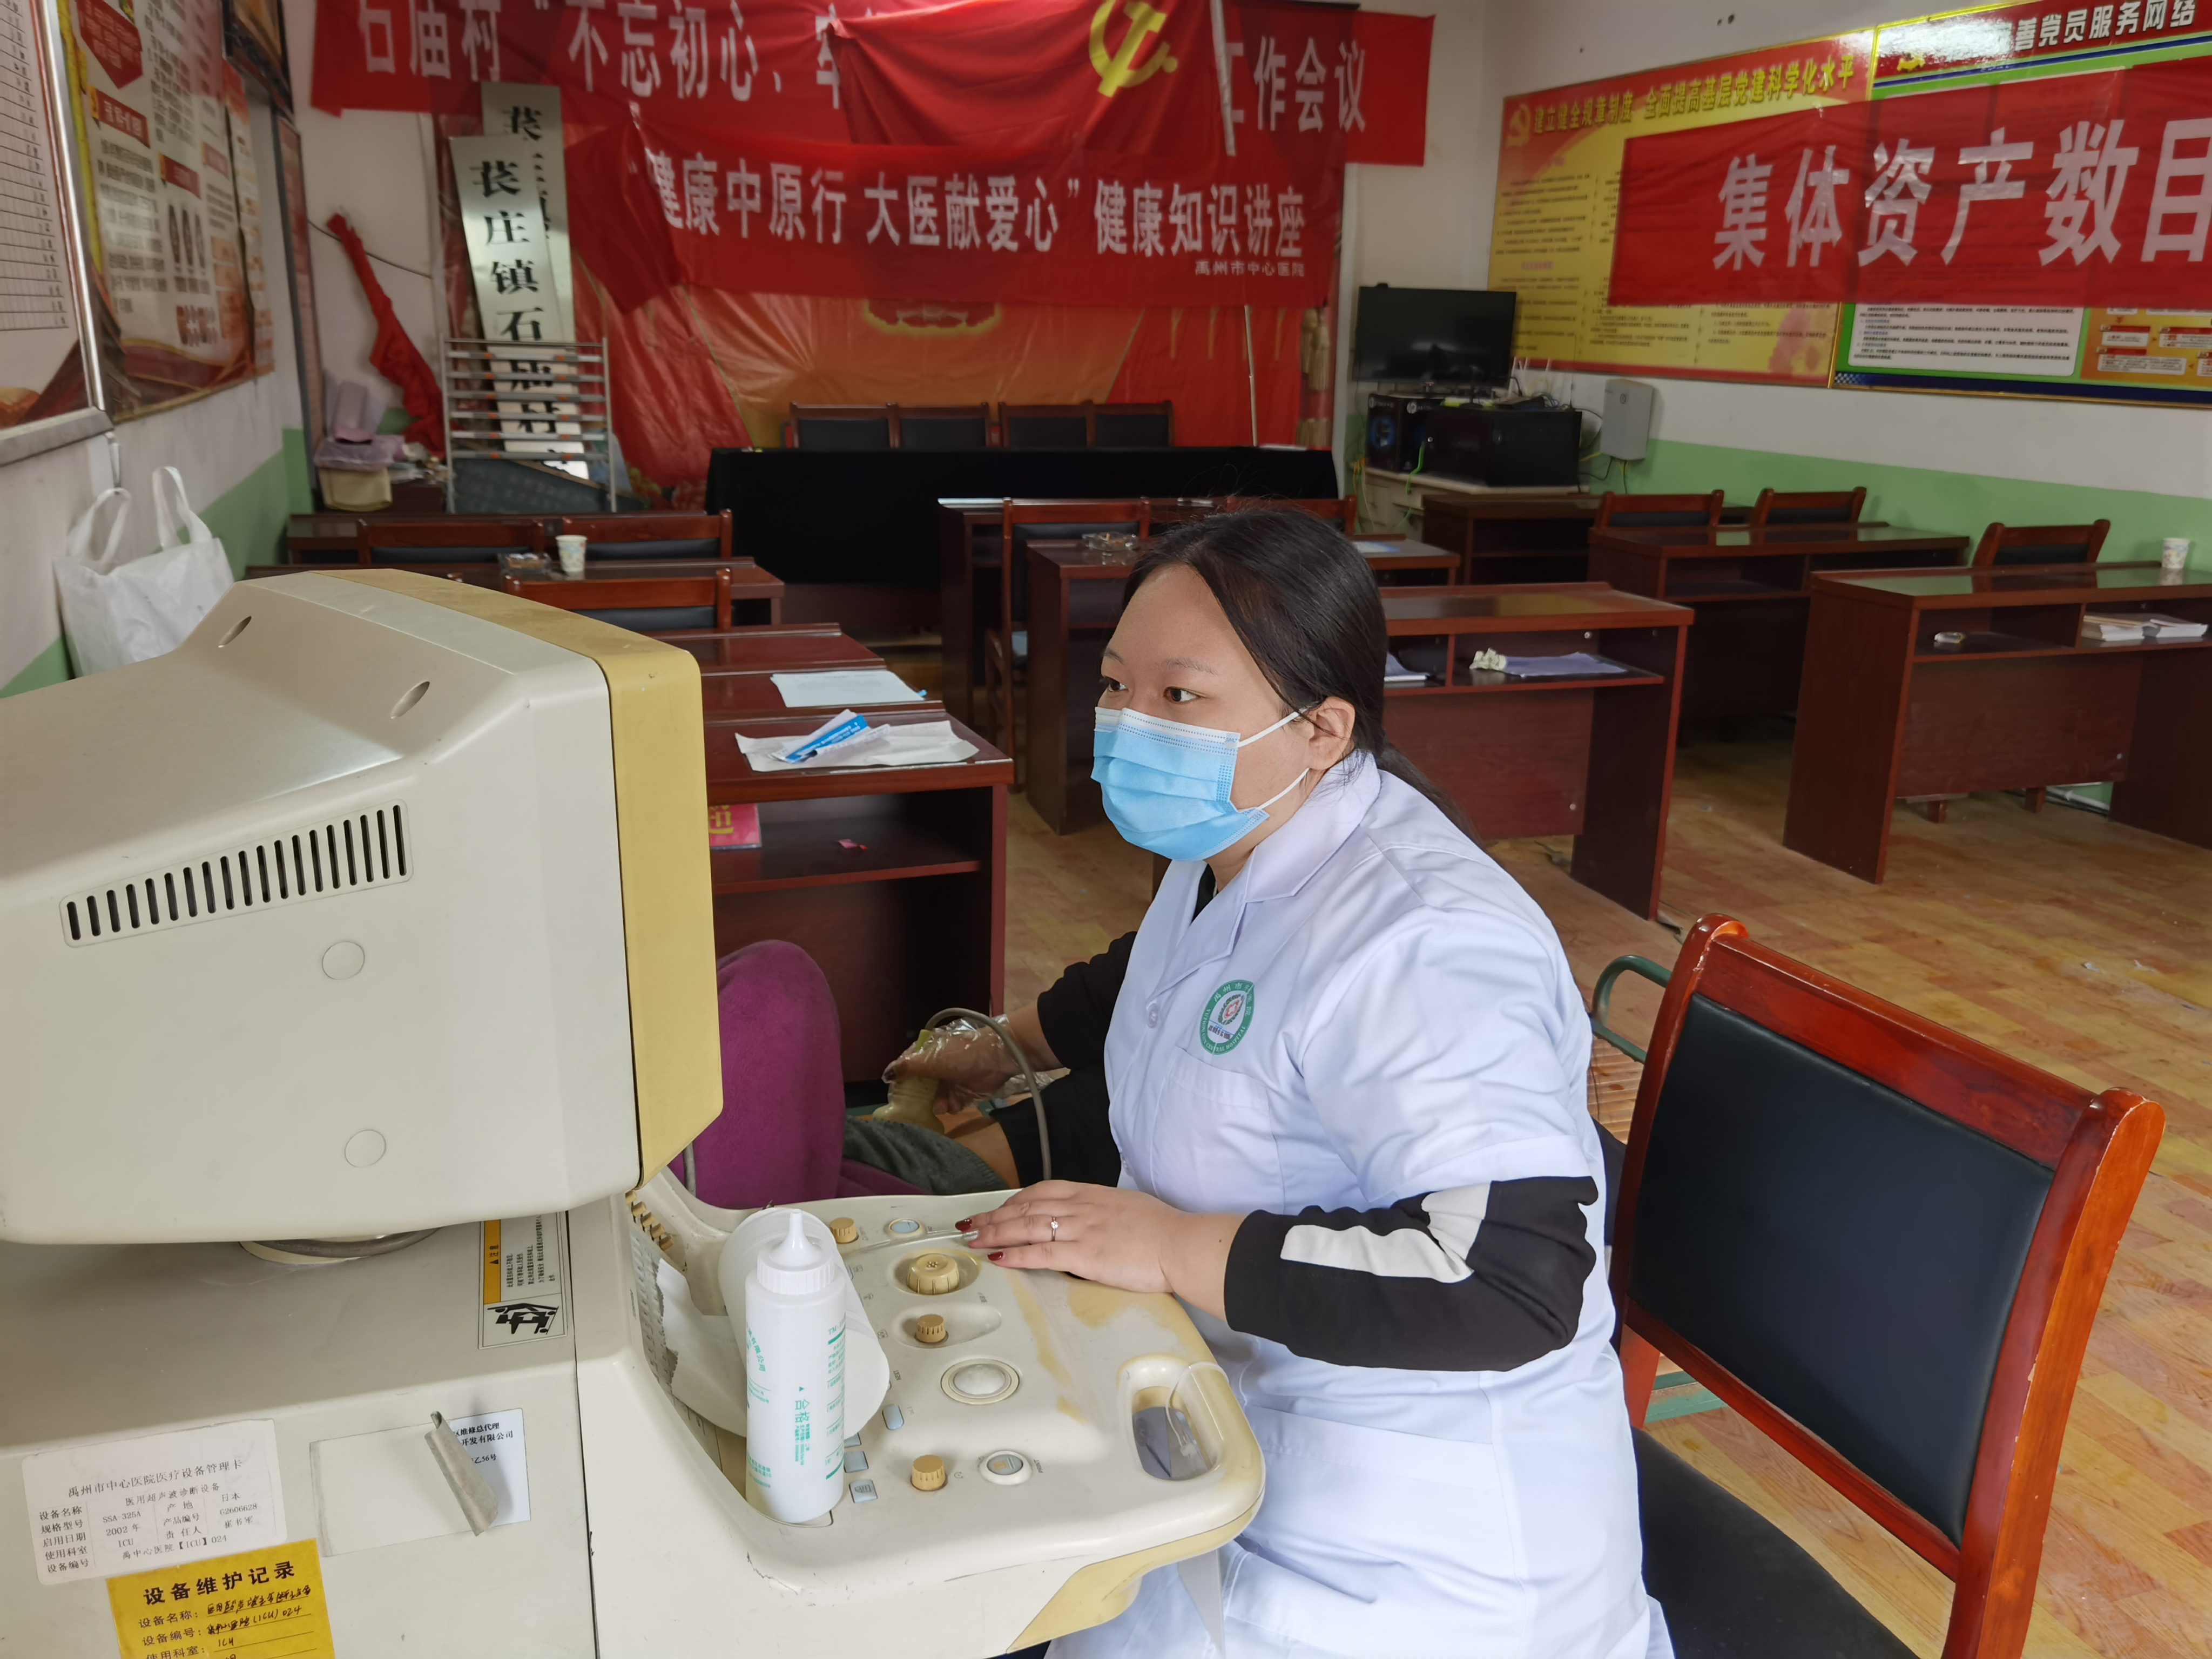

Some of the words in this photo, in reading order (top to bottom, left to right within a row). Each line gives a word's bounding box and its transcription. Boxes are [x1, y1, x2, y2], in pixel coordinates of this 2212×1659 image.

[1644, 55, 1854, 119] 全面提高基层党建科学化水平
[1712, 118, 2212, 270] 集体资产数目
[1094, 179, 1305, 257] 健康知识讲座
[1195, 260, 1305, 277] 禹州市中心医院
[795, 1399, 810, 1423] 合格
[471, 1453, 497, 1464] 乙56号
[69, 1459, 242, 1498] 禹州市中心医院医疗设备管理卡
[39, 1506, 82, 1521] 设备名称
[125, 1482, 220, 1507] 医用超声波诊断设备
[41, 1519, 83, 1534] 规格型号
[221, 1492, 241, 1502] 日本
[43, 1532, 86, 1548] 启用日期
[163, 1513, 200, 1526] 产品编号
[45, 1546, 88, 1561] 使用科室
[118, 1538, 134, 1548] ICU
[48, 1559, 89, 1573] 设备编号
[143, 1560, 295, 1606] 设备维护记录
